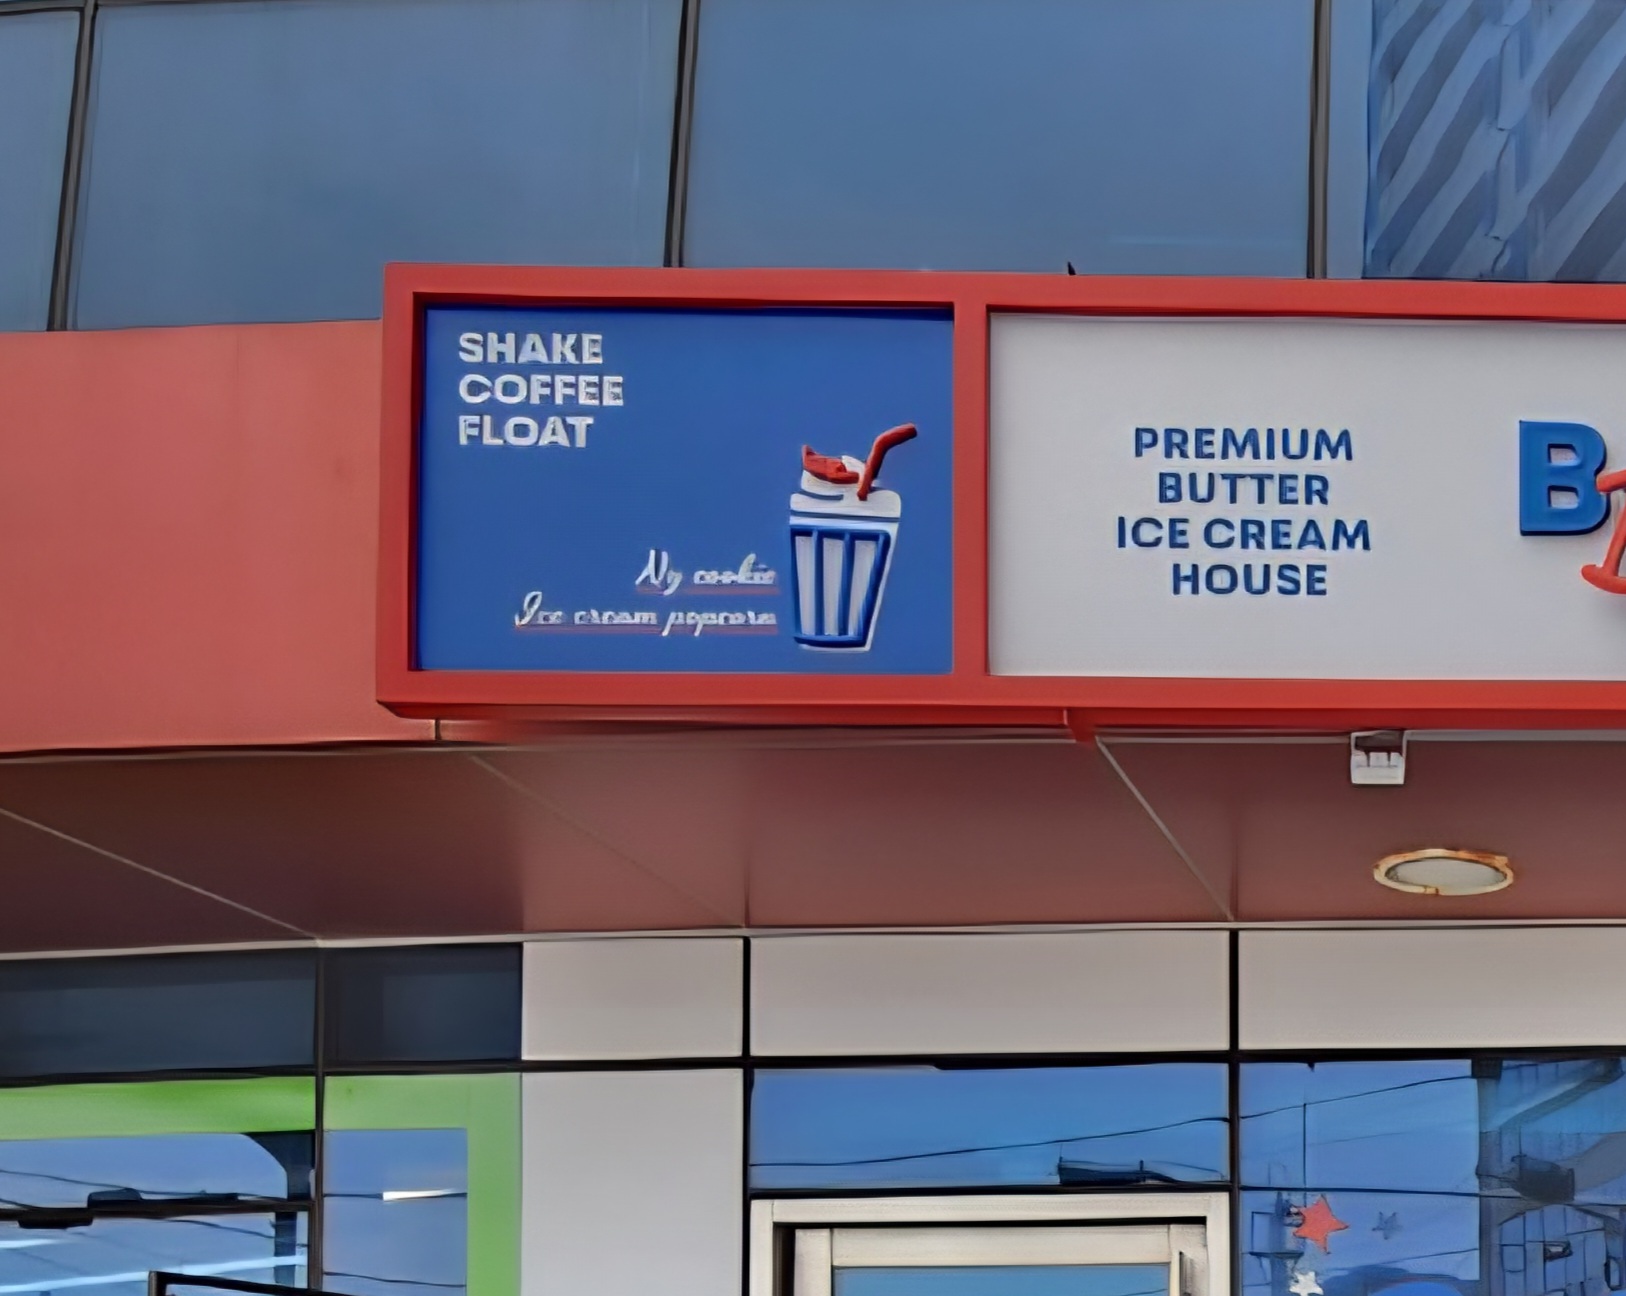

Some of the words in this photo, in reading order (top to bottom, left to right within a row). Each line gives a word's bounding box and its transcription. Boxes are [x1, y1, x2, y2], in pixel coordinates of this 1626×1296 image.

[458, 332, 603, 365] SHAKE
[458, 374, 624, 407] COFFEE
[458, 415, 594, 449] FLOAT
[1134, 426, 1353, 461] PREMIUM
[1158, 471, 1330, 506] BUTTER
[1117, 516, 1190, 549] ICE
[1203, 517, 1371, 551] CREAM
[1172, 563, 1327, 596] HOUSE
